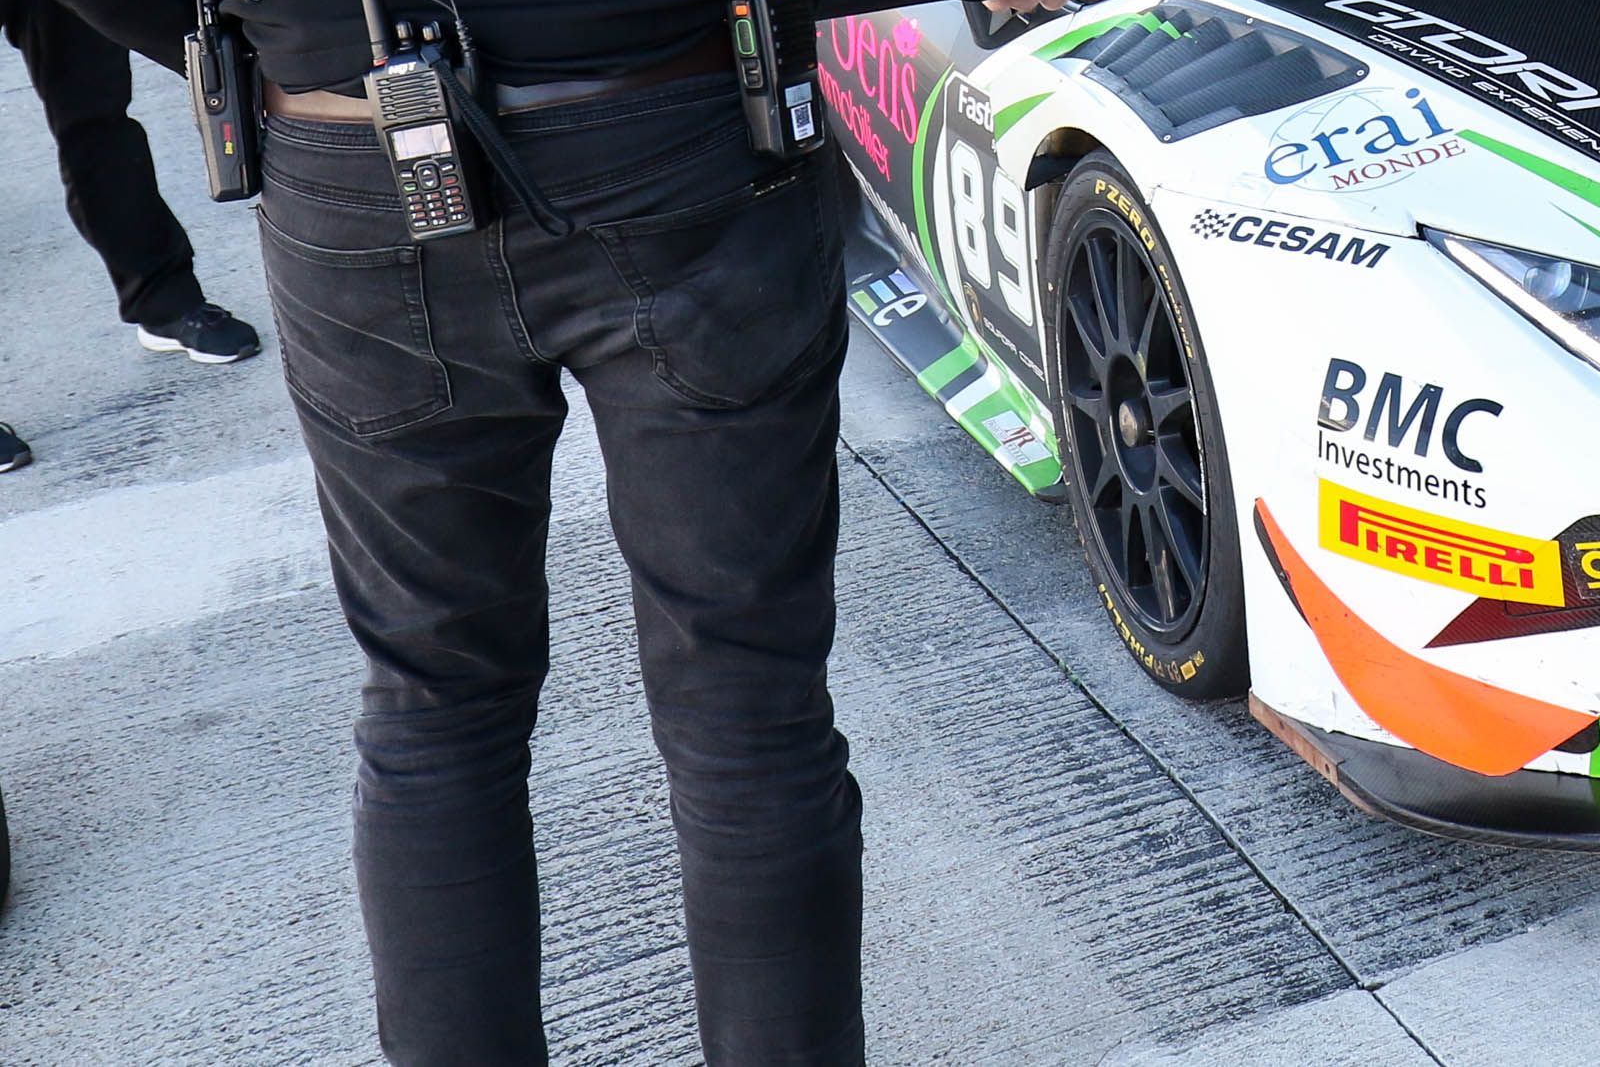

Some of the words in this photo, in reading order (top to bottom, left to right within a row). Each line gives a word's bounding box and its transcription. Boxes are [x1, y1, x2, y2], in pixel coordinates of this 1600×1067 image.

[1367, 34, 1471, 79] DRIVING
[1263, 87, 1454, 187] erai
[1332, 139, 1466, 191] MONDE
[949, 139, 1034, 325] 89
[1230, 214, 1391, 269] CESAM
[1317, 358, 1504, 473] BMC
[1318, 431, 1487, 509] Investments
[1339, 499, 1535, 589] PIRELLI
